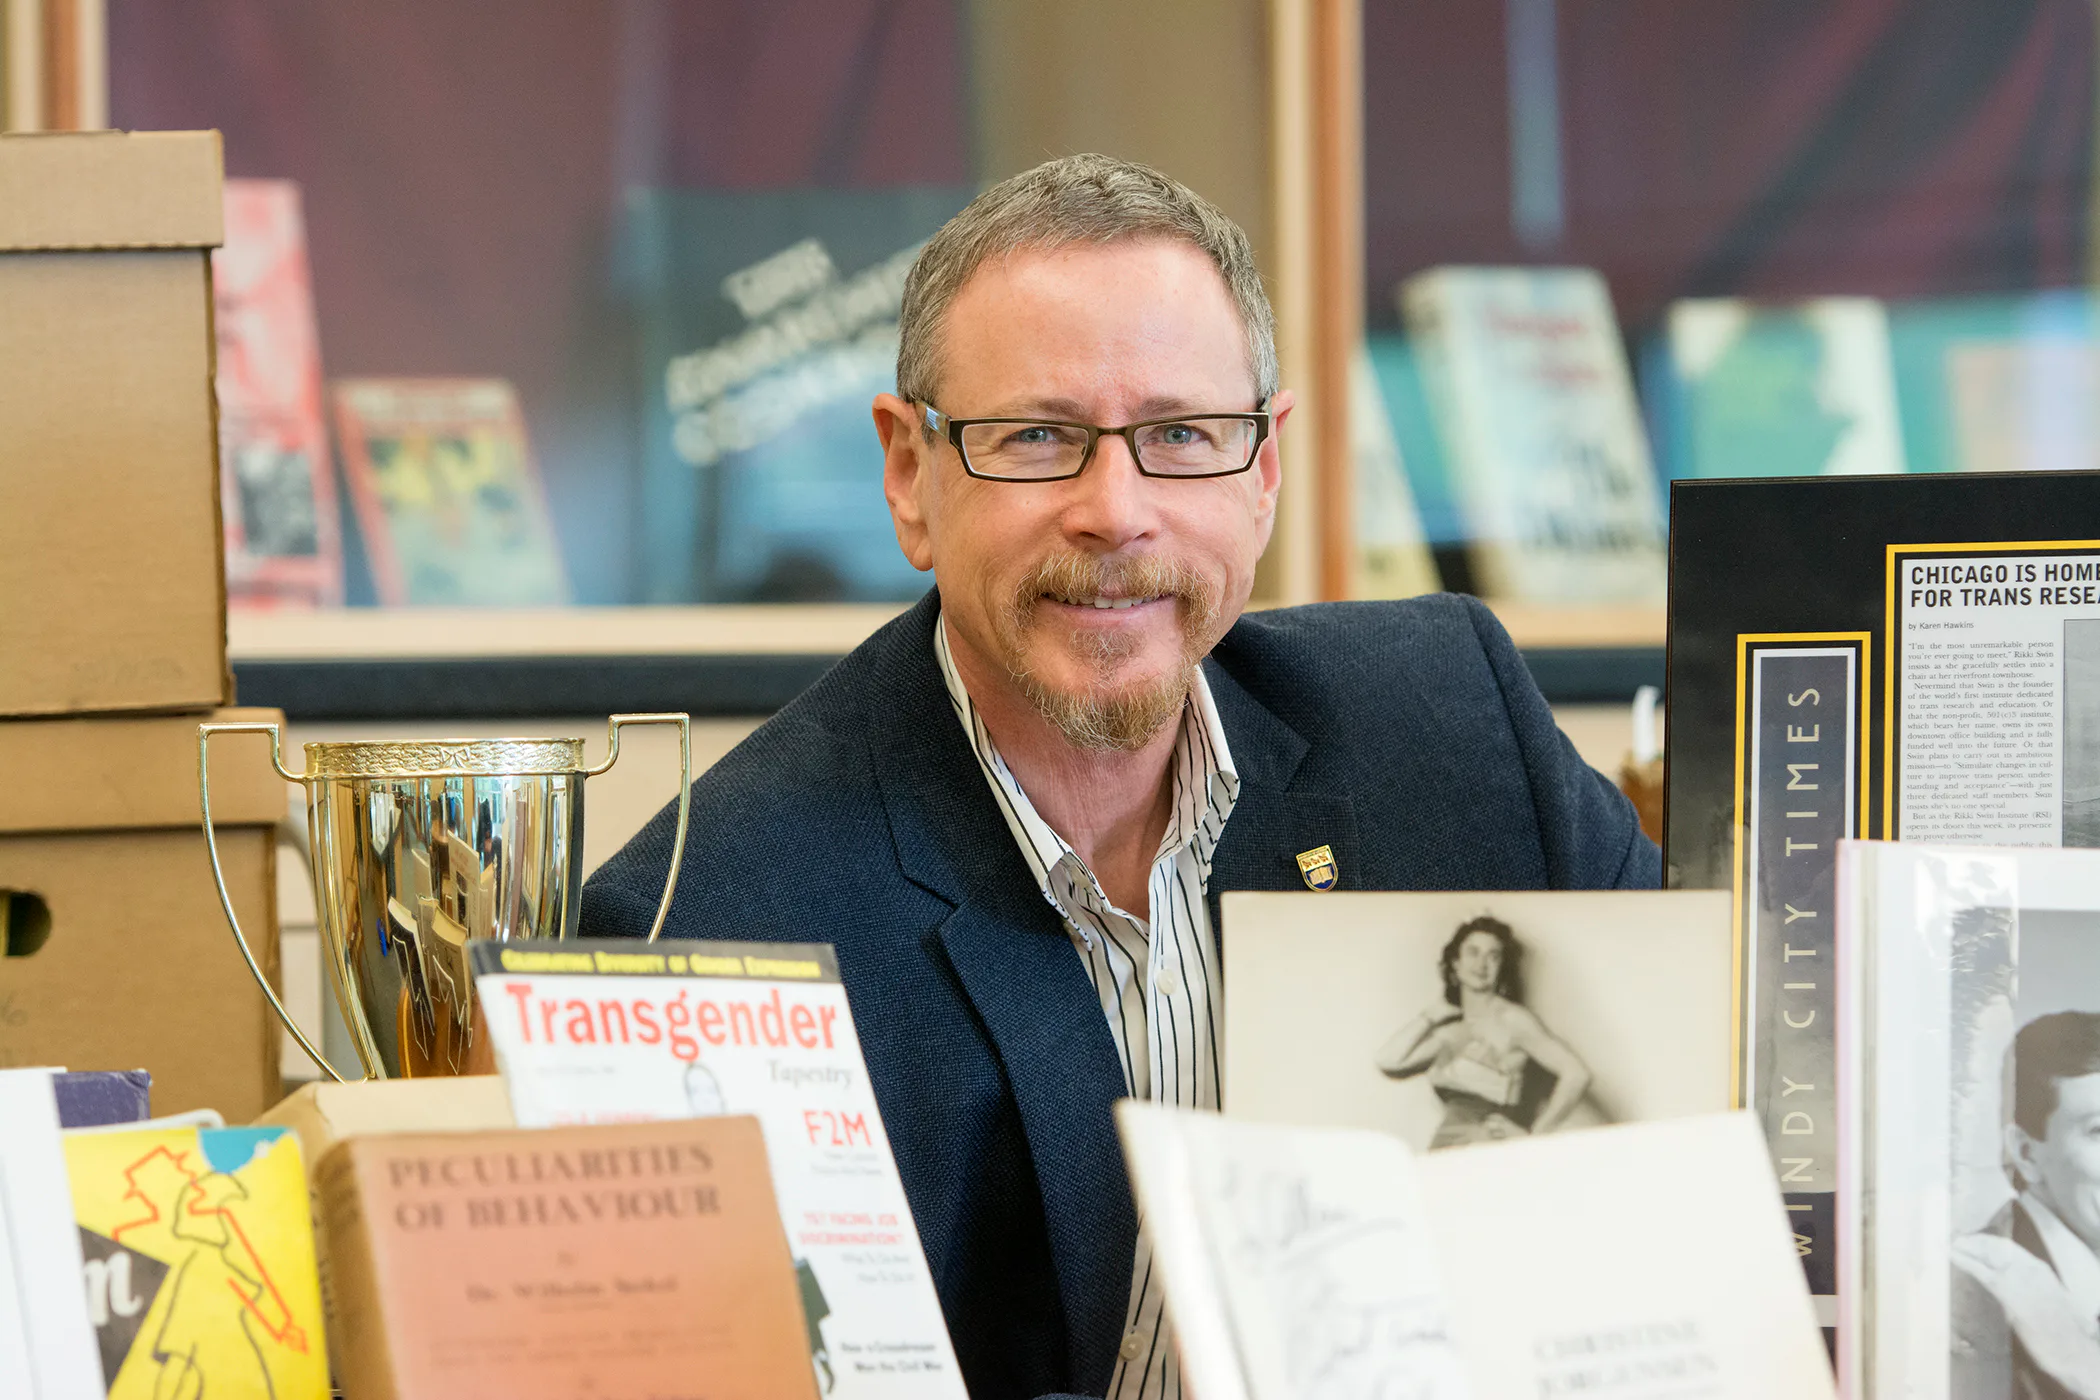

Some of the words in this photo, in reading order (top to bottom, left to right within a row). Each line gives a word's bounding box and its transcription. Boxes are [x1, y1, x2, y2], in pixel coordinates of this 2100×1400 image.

[1911, 564, 2008, 585] CHICAGO
[2015, 563, 2037, 583] IS
[1911, 589, 1952, 608] FOR
[1960, 587, 2032, 606] TRANS
[2040, 586, 2100, 605] RESE
[1919, 620, 1942, 629] Karen
[1944, 620, 1975, 629] Hawkins
[1929, 641, 1942, 649] the
[1970, 640, 2023, 648] unremarkable
[2027, 642, 2053, 650] person
[1908, 652, 1932, 662] you're
[1952, 651, 1974, 661] going
[2013, 650, 2034, 658] Rikki
[2035, 650, 2053, 658] Swin
[1908, 662, 1930, 670] insists
[1945, 661, 1958, 669] she
[1962, 661, 1999, 671] gracefully
[2003, 660, 2026, 668] settles
[2030, 660, 2046, 668] into
[1907, 672, 1926, 680] chair
[1938, 671, 1951, 679] her
[1953, 671, 1990, 679] riverfront
[1914, 681, 1956, 689] Nevermind
[1959, 681, 1974, 689] that
[1977, 681, 1995, 689] Swin
[2007, 680, 2020, 688] the
[2022, 680, 2053, 688] founder
[1919, 692, 1931, 700] the
[1934, 691, 1961, 699] world's
[1964, 691, 1979, 699] first
[1982, 691, 2013, 699] institute
[2016, 690, 2053, 698] dedicated
[1943, 701, 1975, 709] research
[1979, 701, 1994, 709] and
[1907, 712, 1923, 720] that
[1926, 712, 1939, 720] the
[2020, 710, 2053, 720] institute,
[1907, 722, 1929, 730] which
[1933, 721, 1954, 729] bears
[1957, 721, 1970, 729] her
[2024, 720, 2034, 728] its
[1907, 732, 1946, 740] downtown
[1949, 731, 1970, 739] office
[1973, 731, 2006, 741] building
[2009, 730, 2024, 738] and
[2036, 730, 2053, 740] fully
[1785, 688, 1821, 857] TIMES
[1783, 903, 1818, 1028] CITY
[505, 983, 837, 1064] Transgender
[768, 1060, 853, 1090] Tapestry
[803, 1109, 873, 1148] F2M
[386, 1143, 715, 1189] PECULIARITIES
[394, 1201, 444, 1231] OF
[466, 1186, 721, 1229] BEHAVIOUR
